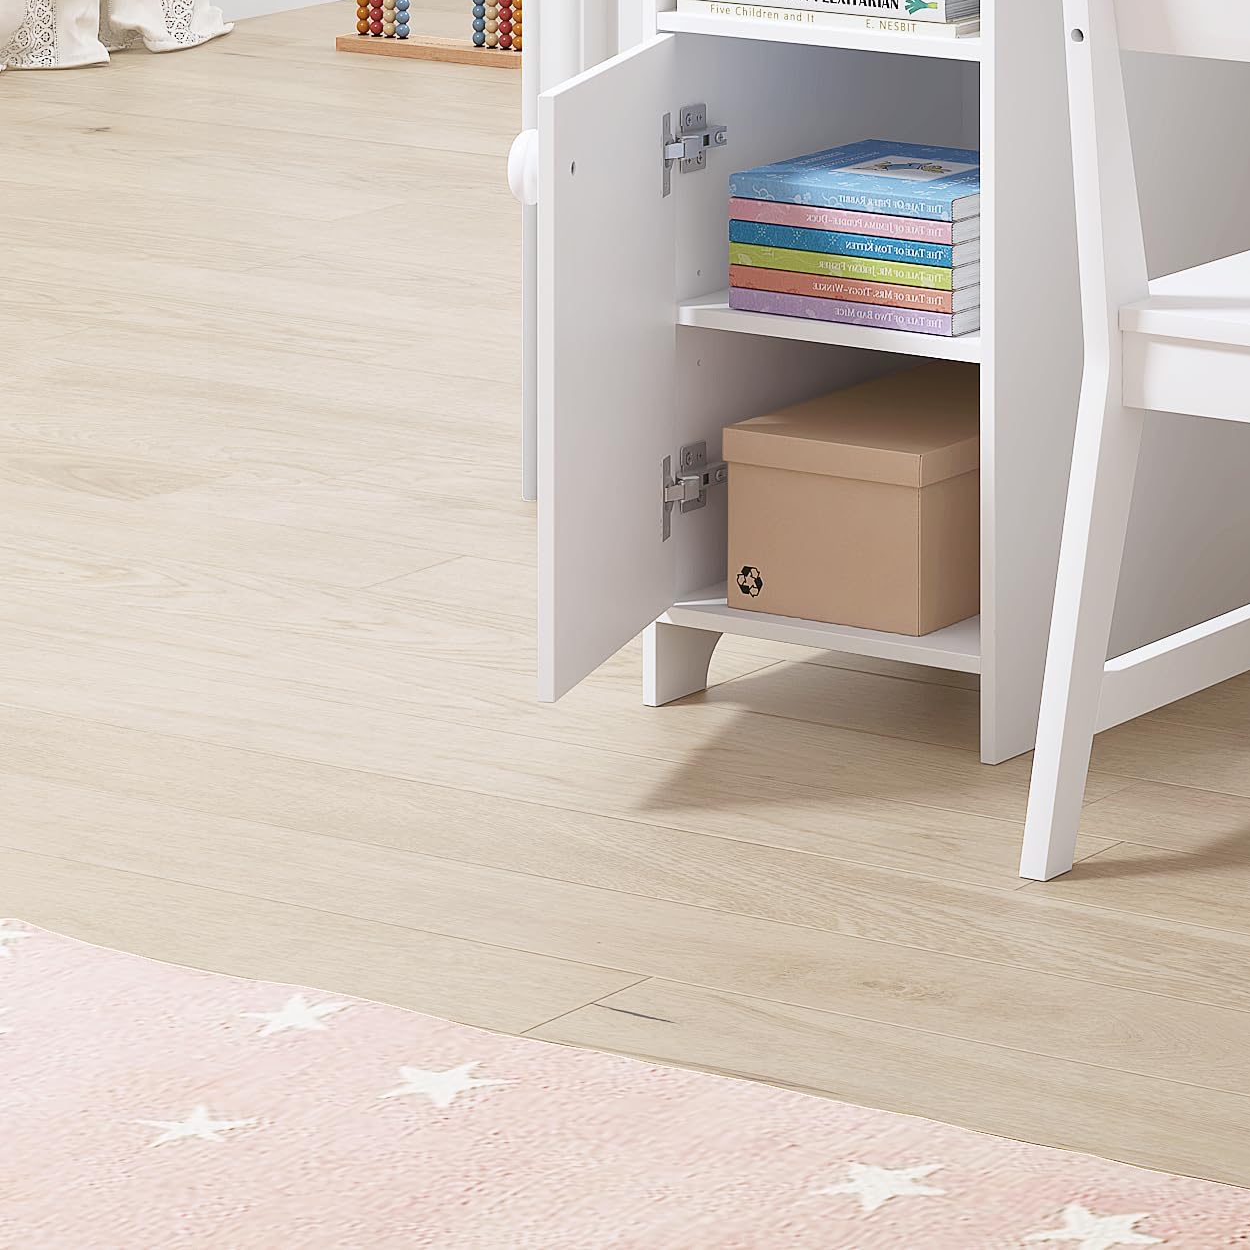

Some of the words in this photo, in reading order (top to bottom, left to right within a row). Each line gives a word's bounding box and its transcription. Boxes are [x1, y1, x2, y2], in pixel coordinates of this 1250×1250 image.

[710, 4, 731, 14] Five
[736, 6, 779, 20] Children
[784, 12, 802, 22] and
[807, 14, 815, 22] It
[866, 18, 875, 29] E.
[880, 20, 917, 33] NESBIT
